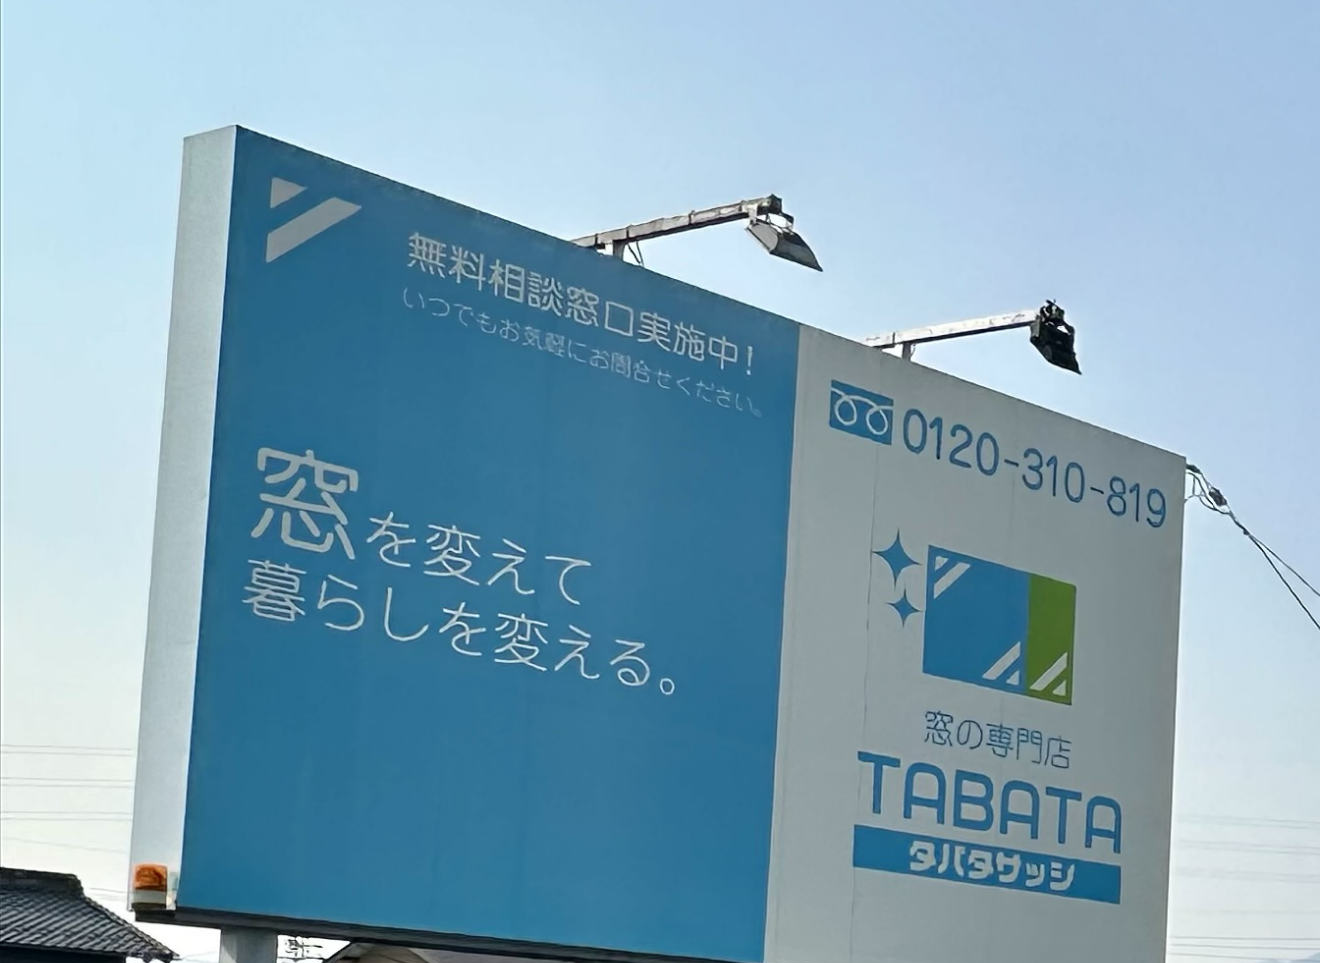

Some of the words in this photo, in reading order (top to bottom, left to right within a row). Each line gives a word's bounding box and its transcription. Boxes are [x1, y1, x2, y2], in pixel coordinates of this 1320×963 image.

[401, 286, 762, 419] いつでもお気軽にお問合せください。
[408, 231, 754, 376] 無料相談窓口実施中!
[249, 446, 592, 606] 窓を変えて
[902, 408, 1168, 529] 0120-310-819
[242, 558, 676, 696] 暮らしを変える。
[856, 750, 1123, 855] TABATA
[923, 710, 1072, 770] 窓の専門店
[908, 839, 1077, 891] タバタサッシ
